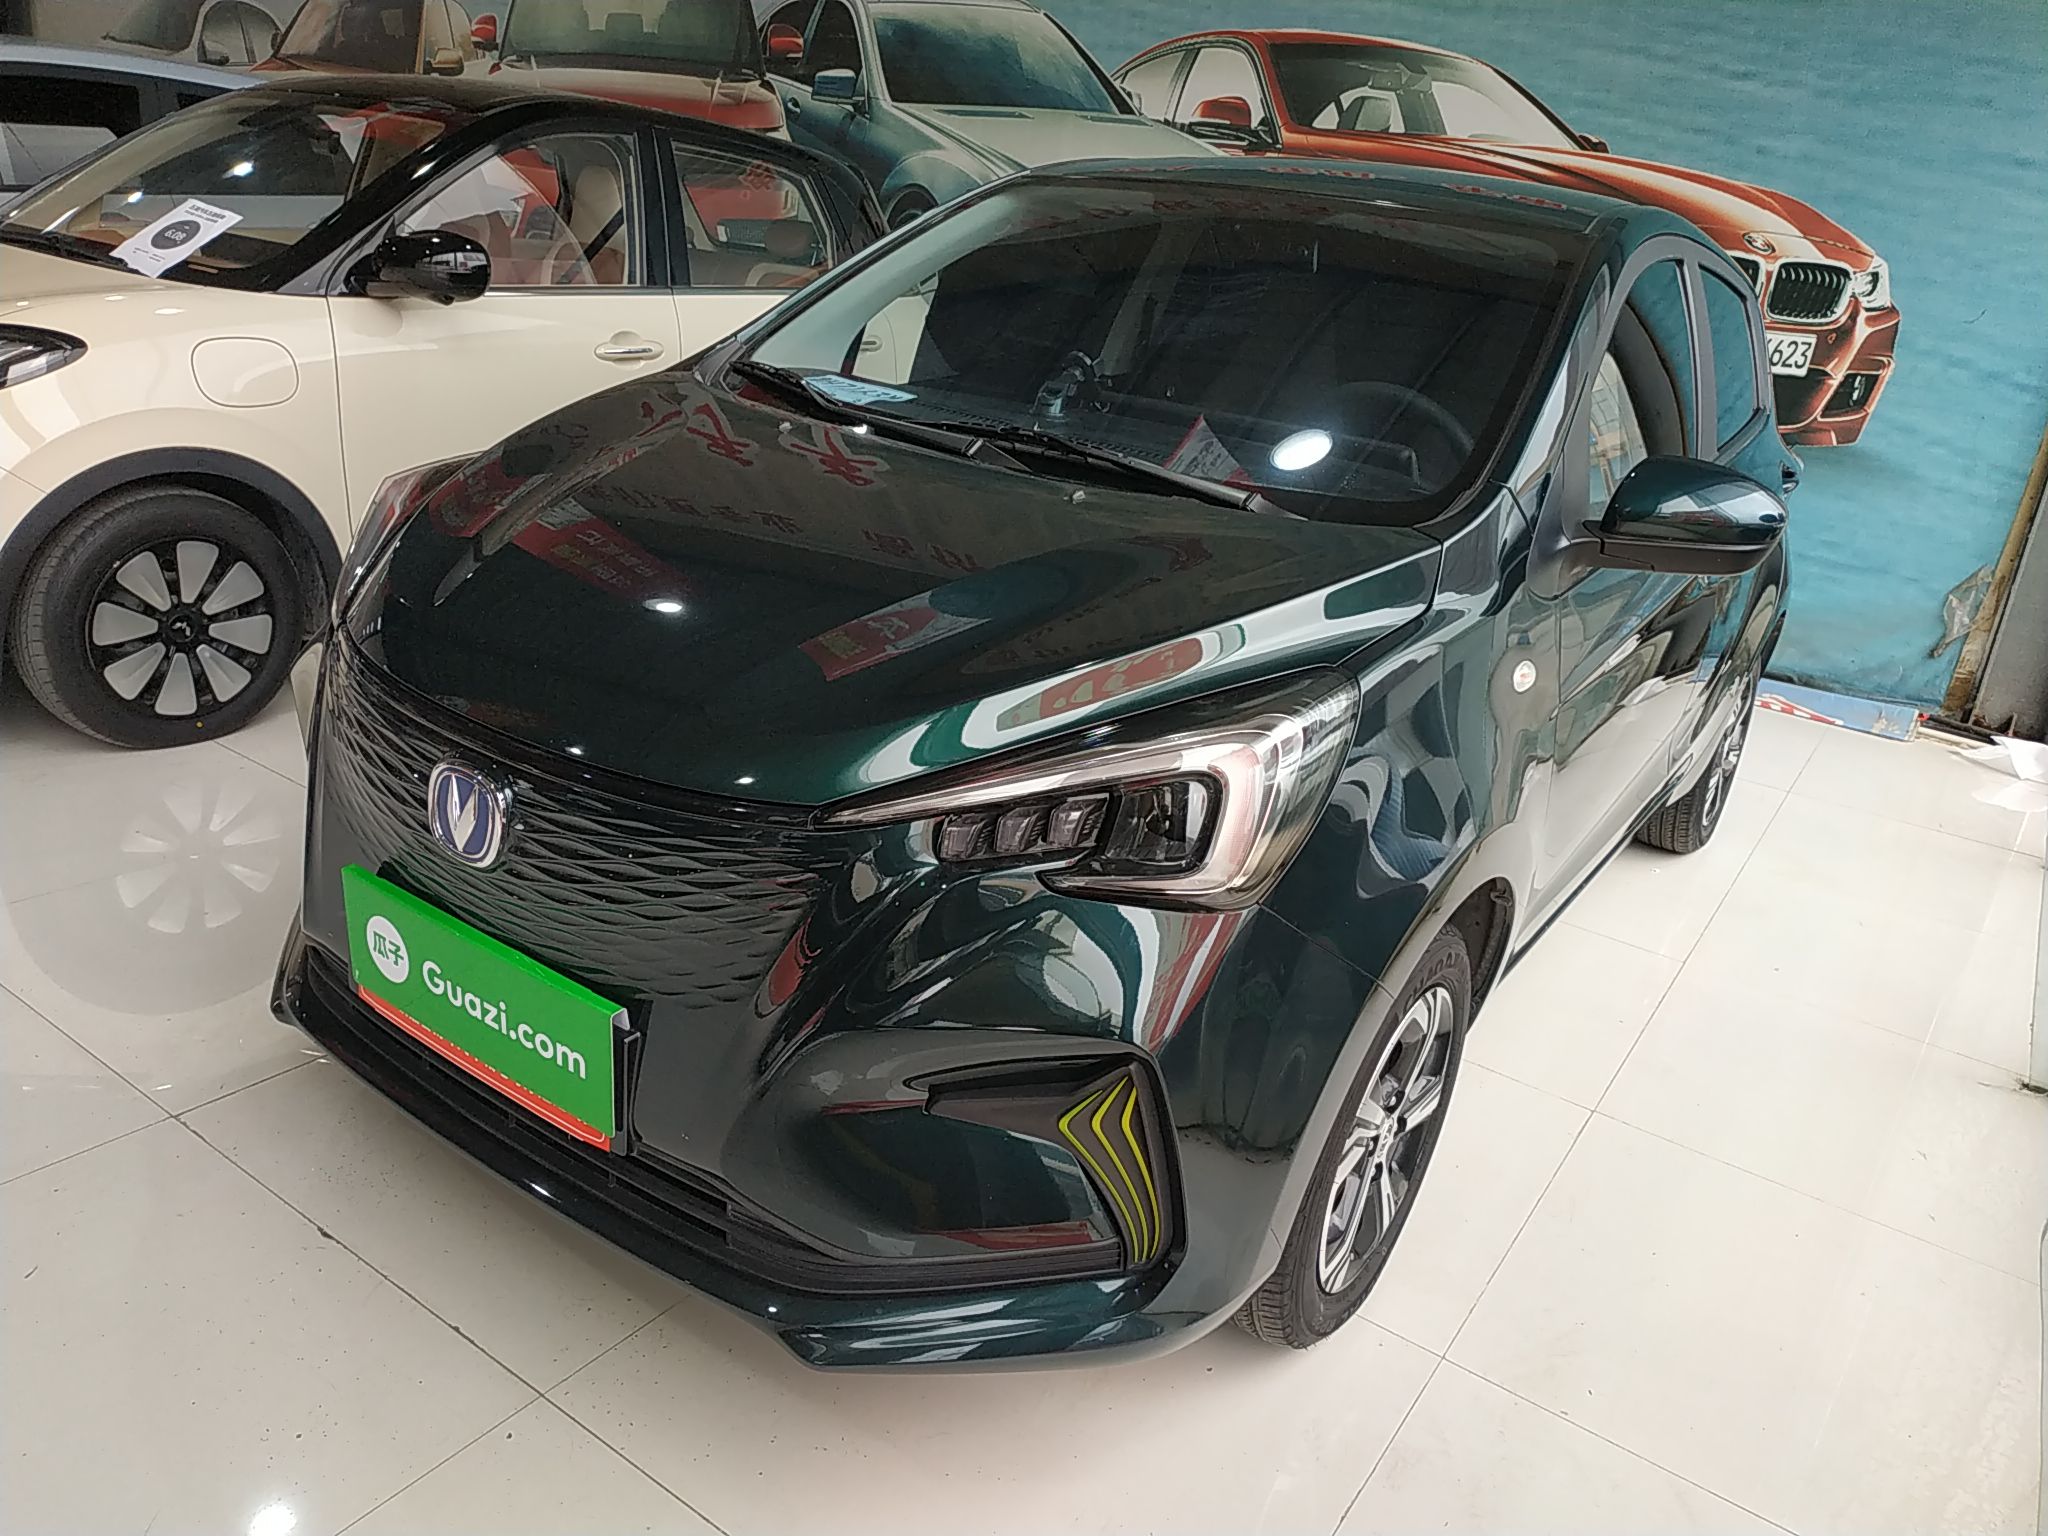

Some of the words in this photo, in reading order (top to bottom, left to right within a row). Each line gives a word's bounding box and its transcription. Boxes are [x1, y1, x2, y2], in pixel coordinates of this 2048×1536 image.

[1767, 338, 1813, 369] 623
[373, 930, 405, 967] 瓜子
[422, 960, 587, 1080] Guazi.com
